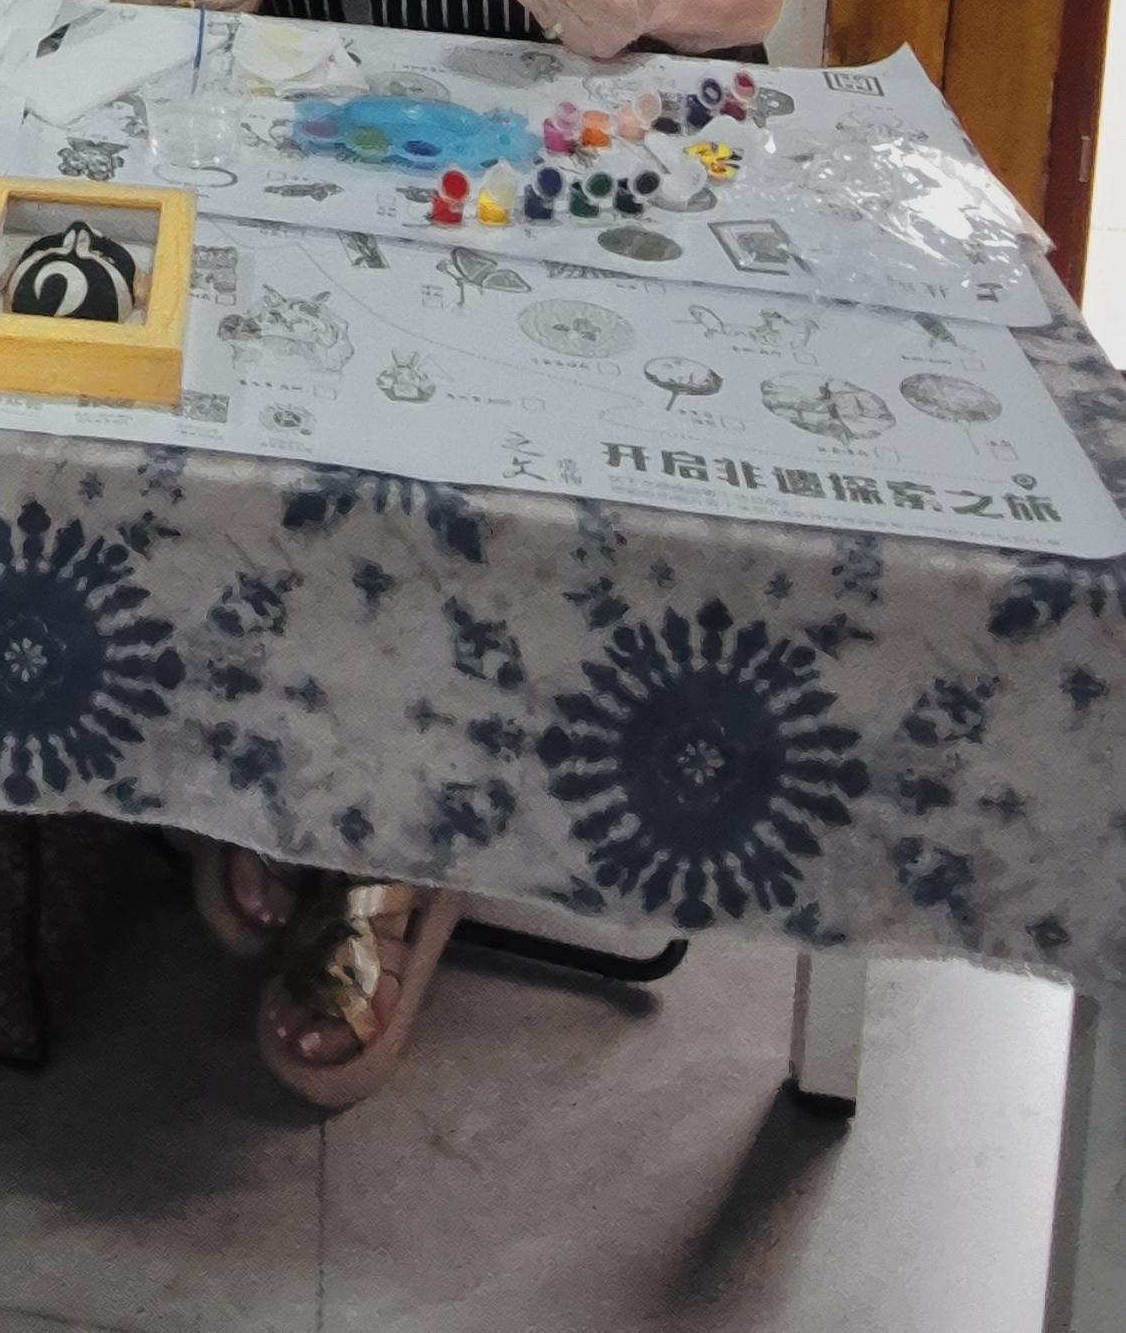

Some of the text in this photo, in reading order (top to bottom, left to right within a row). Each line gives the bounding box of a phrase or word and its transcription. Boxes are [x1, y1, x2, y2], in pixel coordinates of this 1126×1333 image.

[600, 440, 1063, 523] 开启非遗探索之旅
